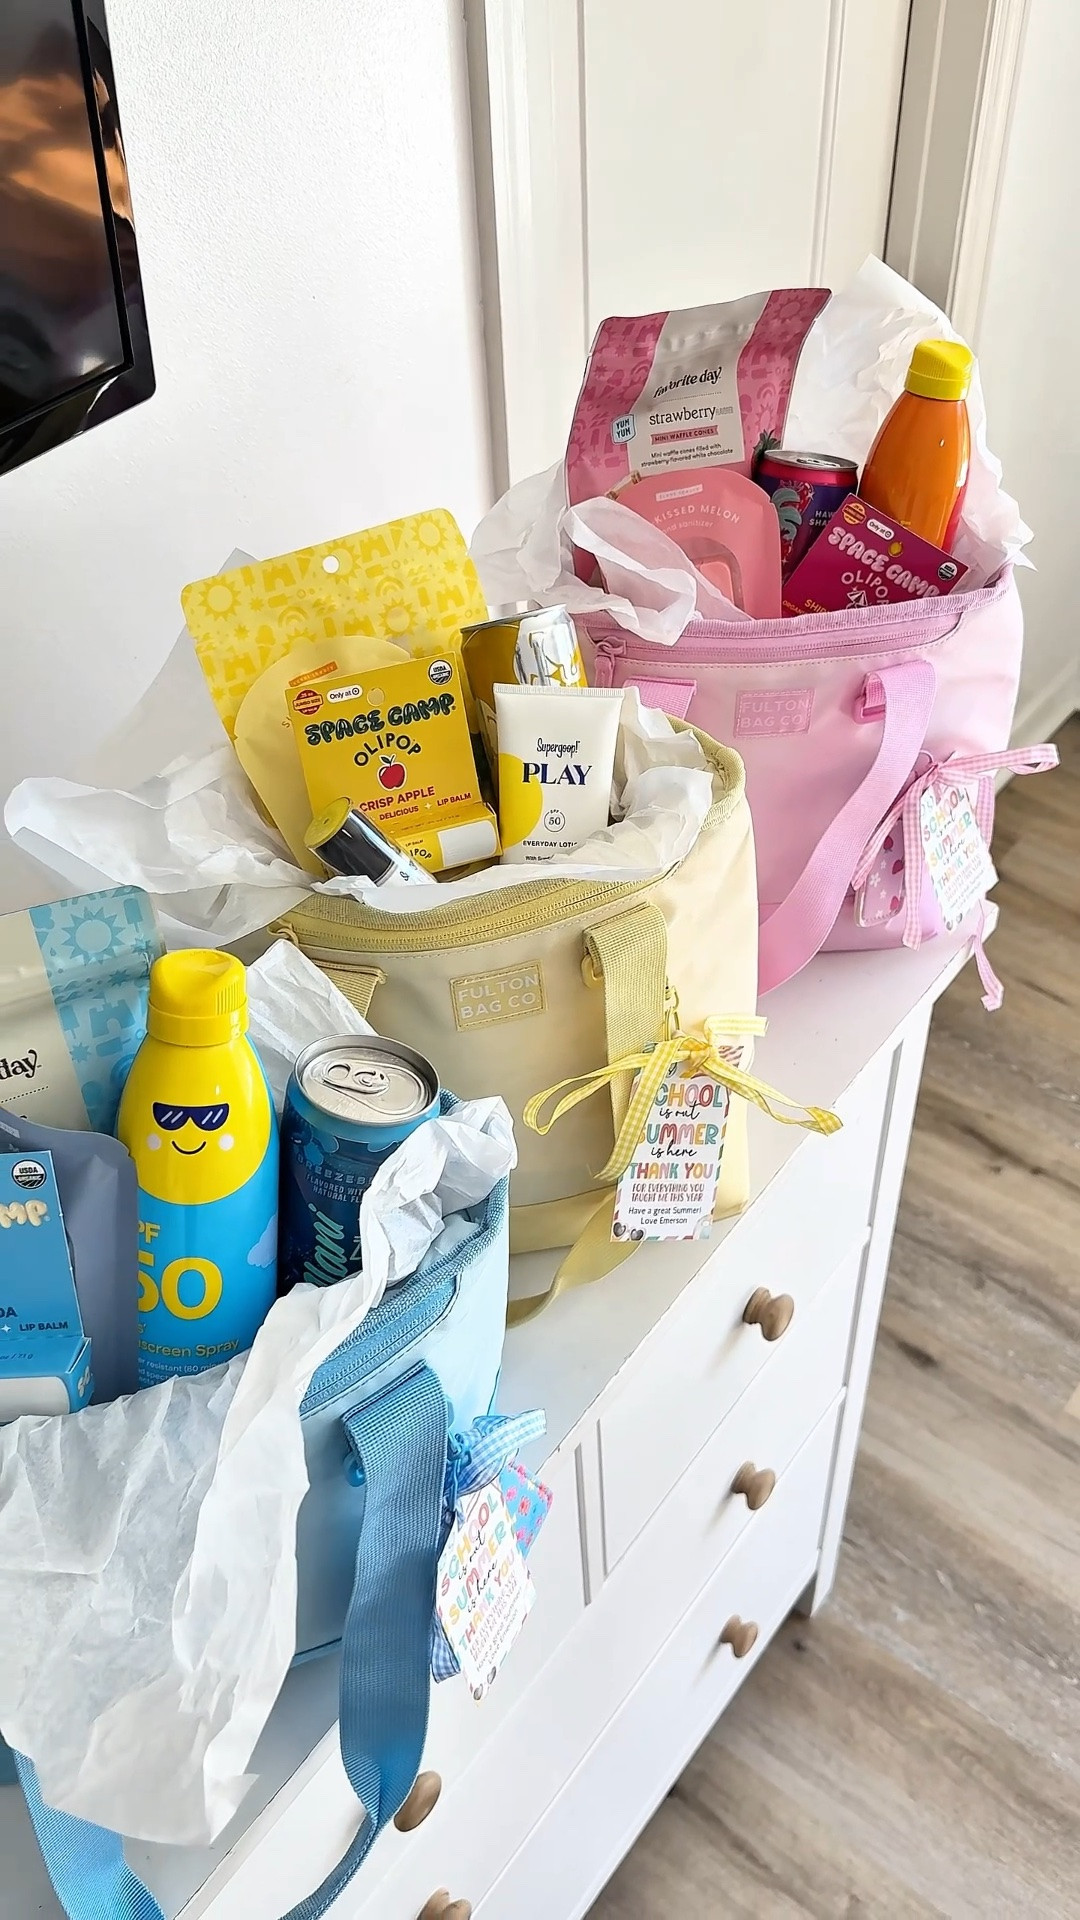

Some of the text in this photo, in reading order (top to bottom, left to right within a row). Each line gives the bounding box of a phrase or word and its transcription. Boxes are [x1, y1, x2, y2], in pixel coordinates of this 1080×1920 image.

[653, 372, 698, 399] favorite
[616, 418, 630, 429] YUM
[649, 406, 717, 426] strawberry
[616, 427, 631, 439] YUM
[654, 428, 714, 442] MINI WAFFLE CONES
[700, 504, 740, 524] MELON
[809, 518, 827, 526] SHA
[663, 519, 714, 534] and sanitizer
[869, 521, 880, 532] Only
[828, 526, 940, 598] SPACE CAMP
[329, 690, 344, 700] Only
[741, 698, 809, 713] FULTON
[304, 693, 455, 746] SPACE CAMP
[740, 714, 803, 729] BAG CO
[354, 732, 422, 767] OLIPOP
[522, 762, 593, 786] PLAY
[359, 786, 436, 812] CRISP APPLE
[379, 792, 472, 821] DELICIOUS LIP BALM
[548, 816, 561, 826] 50
[410, 848, 432, 859] IPOP
[523, 840, 558, 848] EVERYDAY
[458, 973, 539, 1002] FULTON
[460, 992, 536, 1019] BAG CO
[655, 1083, 722, 1108] CHOOL
[659, 1100, 700, 1120] is out
[651, 1139, 697, 1158] is here
[297, 1153, 373, 1186] BREEZEB
[630, 1162, 714, 1180] THANK YOU
[306, 1174, 364, 1196] FLAVORED WIT
[313, 1185, 361, 1203] NATURAL FL
[632, 1183, 705, 1192] FOR EVERYTHING YOU
[631, 1193, 704, 1202] TAUGHT ME THIS YEAR
[653, 1208, 671, 1216] great
[660, 1216, 688, 1224] Emerson
[137, 1220, 161, 1244] PF
[137, 1250, 223, 1321] 50
[19, 1321, 69, 1331] LIP BALM
[138, 1339, 240, 1359] screen Spray
[146, 1361, 182, 1373] resistant
[441, 1492, 498, 1597] SCHOOL
[449, 1520, 507, 1625] SUMMER
[458, 1547, 515, 1650] THANK YOU
